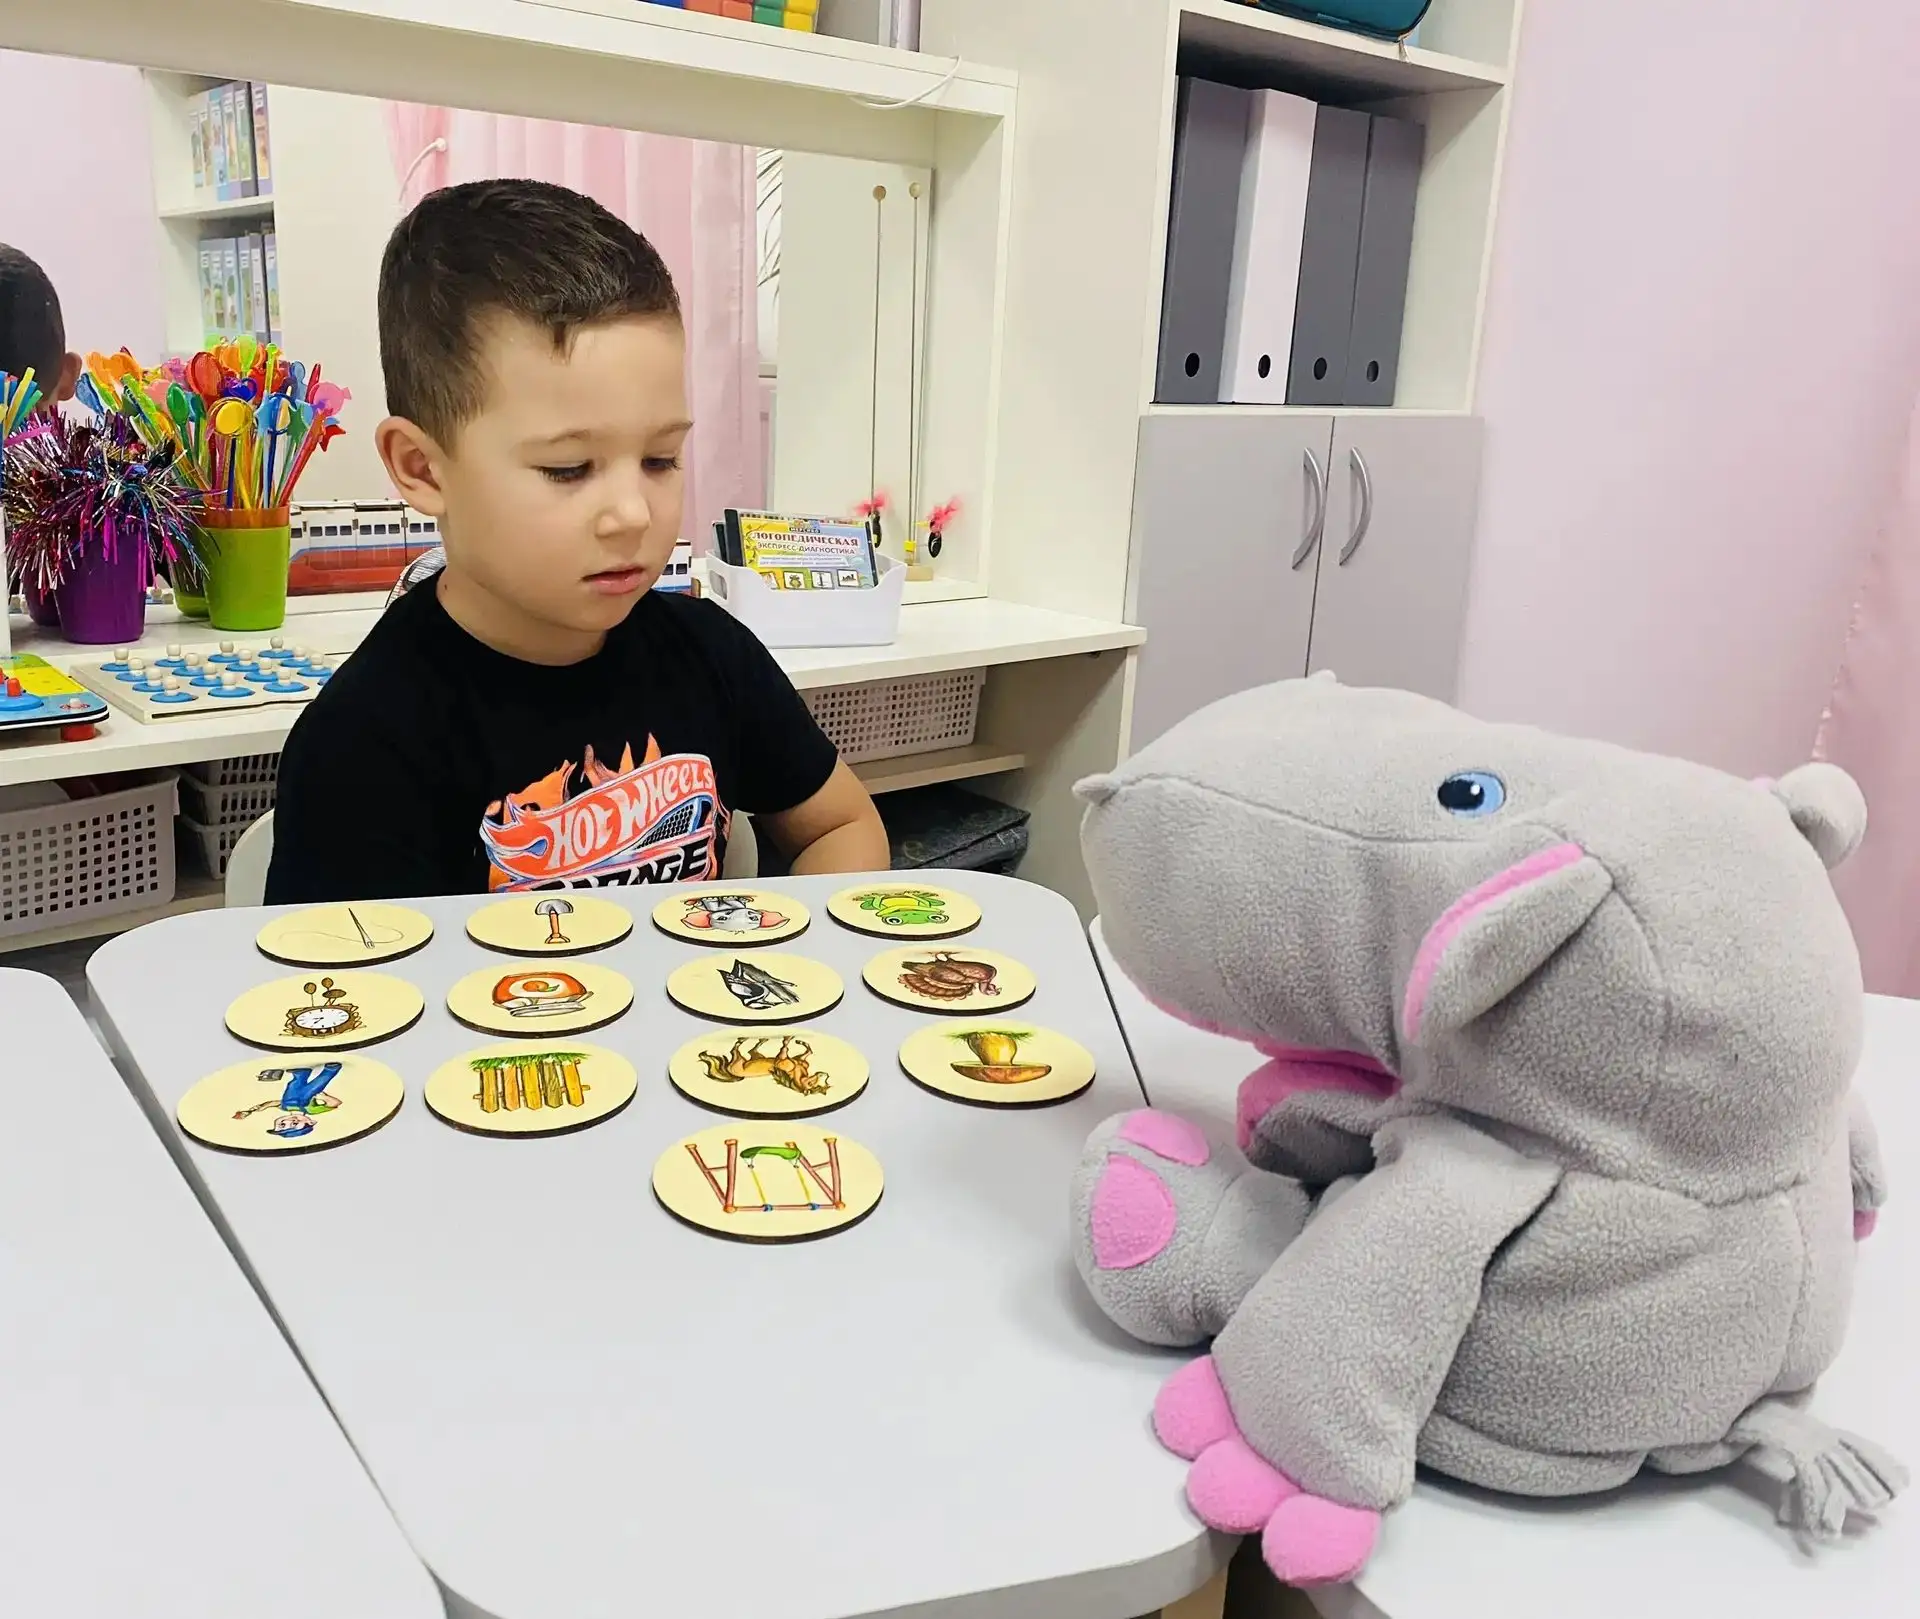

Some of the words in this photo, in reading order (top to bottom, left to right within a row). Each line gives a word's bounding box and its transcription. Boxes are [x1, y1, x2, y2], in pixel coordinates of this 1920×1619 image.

[752, 531, 859, 547] ЛОГОПЕДИЧЕСКАЯ
[757, 541, 856, 555] ЭКСПРЕСС-ДИАГНОСТИКА
[543, 802, 615, 870] HOT
[530, 835, 712, 892] AGE
